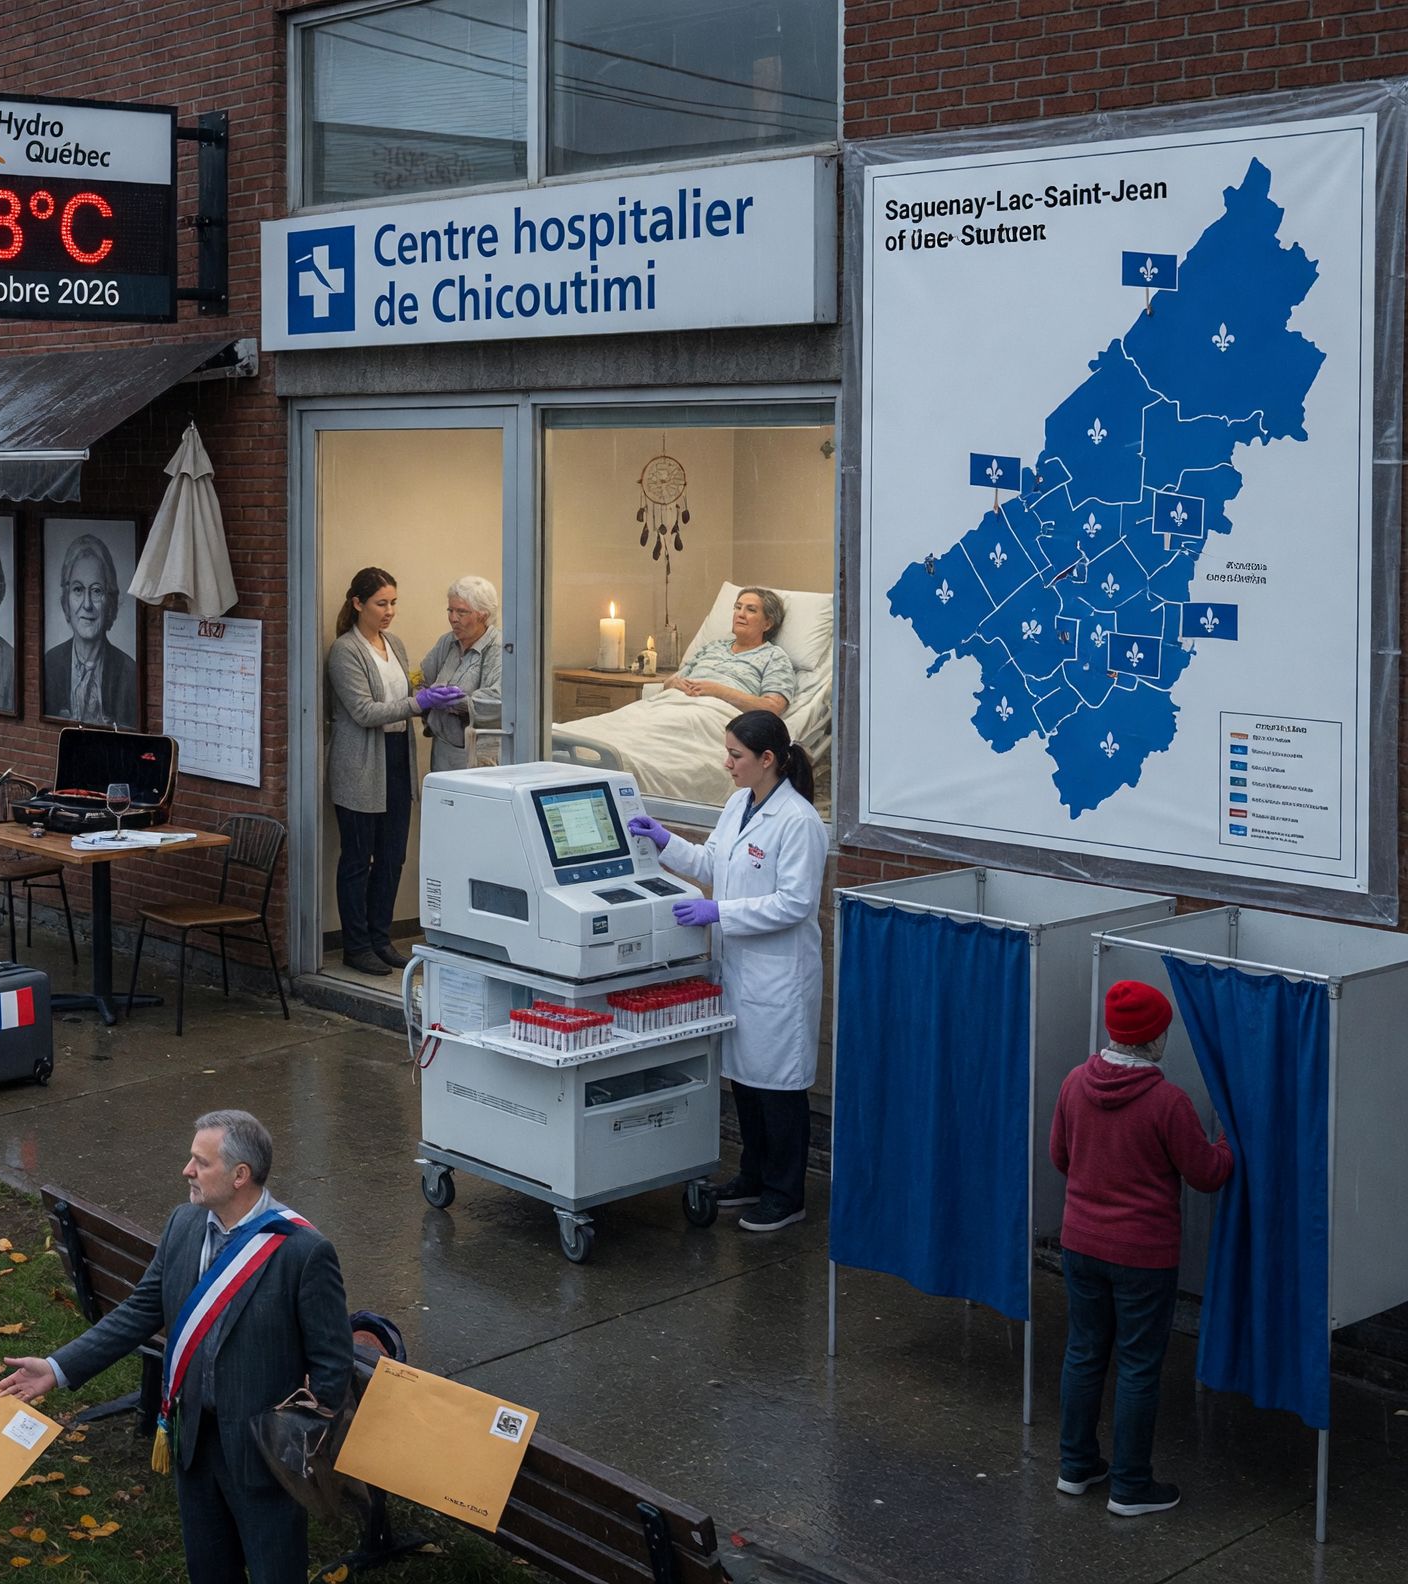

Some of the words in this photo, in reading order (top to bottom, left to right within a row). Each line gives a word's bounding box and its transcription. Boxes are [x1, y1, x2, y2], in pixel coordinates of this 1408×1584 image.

[25, 141, 111, 168] Québec
[885, 179, 1167, 224] Saguenay-Lac-Saint-Jean
[373, 220, 499, 267] Centre
[513, 188, 754, 261] hospitalier
[885, 229, 906, 251] of
[57, 278, 120, 306] 2026
[373, 281, 419, 327] de
[432, 259, 656, 323] Chicoutimi
